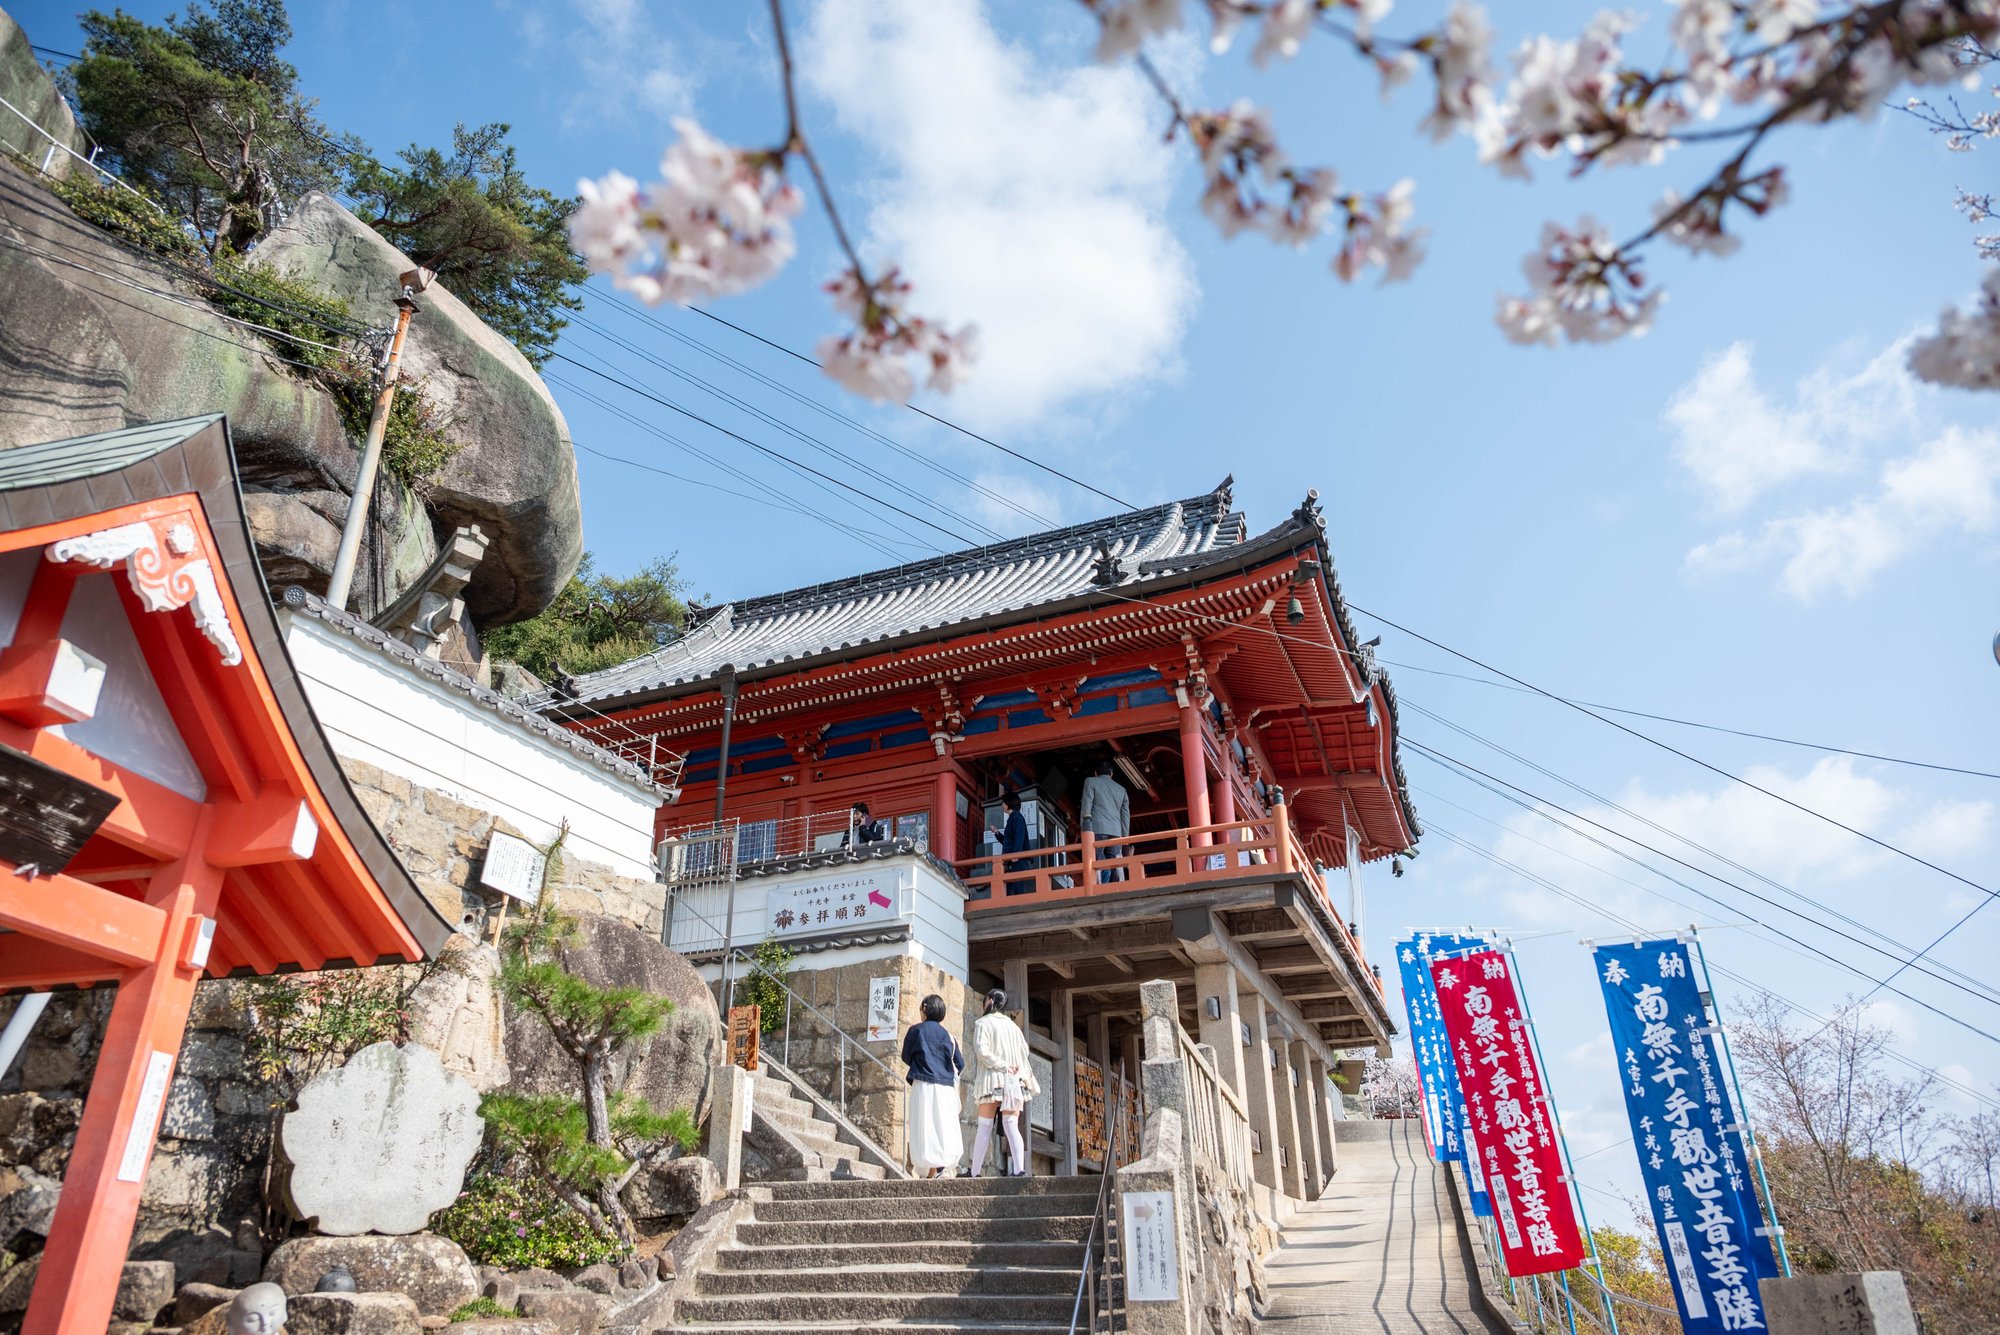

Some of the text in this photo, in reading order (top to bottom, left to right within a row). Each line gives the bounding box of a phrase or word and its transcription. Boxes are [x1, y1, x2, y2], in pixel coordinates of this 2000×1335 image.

[793, 878, 874, 897] よくお参りくださいました
[808, 892, 856, 907] 千光寺 本堂
[799, 904, 867, 926] 参拝順路
[1401, 948, 1417, 965] 奉
[1603, 951, 1686, 987] 奉 納
[1437, 957, 1506, 990] 奉 納
[872, 987, 882, 1010] 本堂へ
[883, 984, 896, 1010] 順路
[1463, 984, 1564, 1257] 南無千手観世音菩薩
[1472, 1091, 1491, 1135] 千光寺
[1485, 1145, 1501, 1173] 願主
[1633, 983, 1766, 1332] 南無千手観世音菩薩
[1639, 1115, 1665, 1171] 千光寺
[1656, 1184, 1679, 1220] 願主
[1843, 1284, 1871, 1335] 弘法
